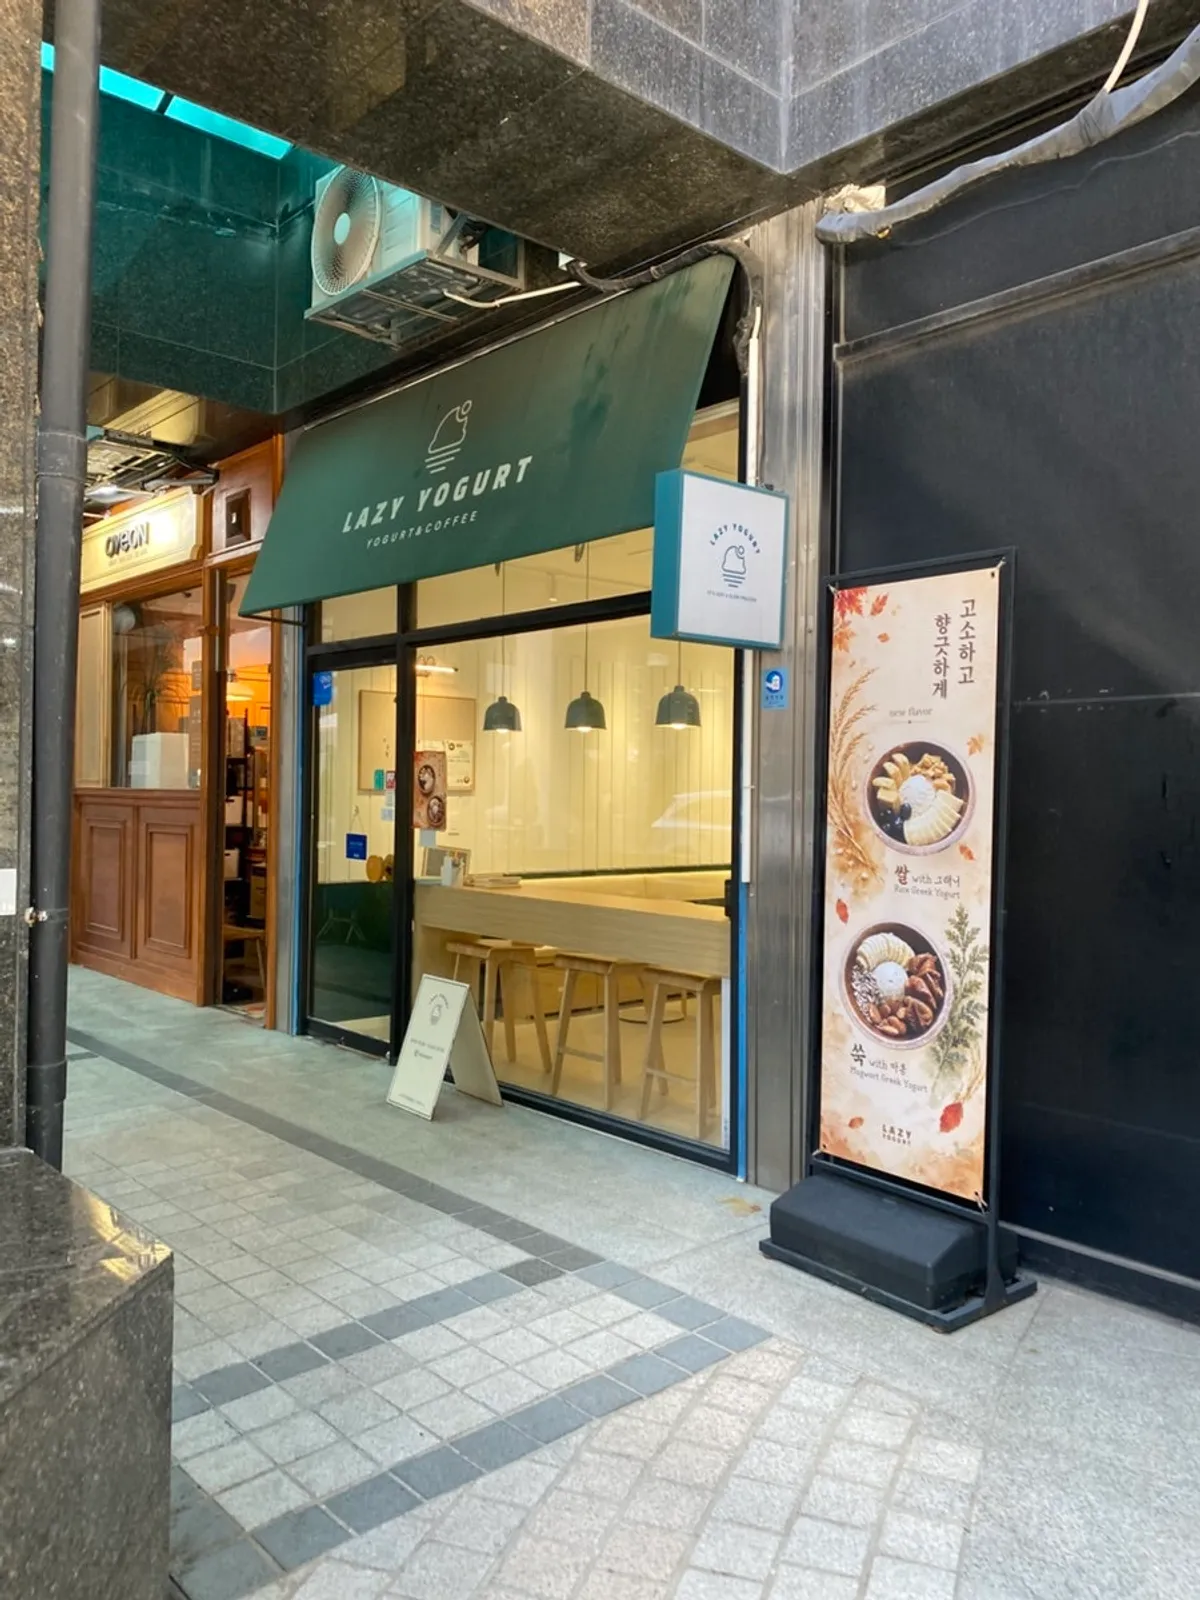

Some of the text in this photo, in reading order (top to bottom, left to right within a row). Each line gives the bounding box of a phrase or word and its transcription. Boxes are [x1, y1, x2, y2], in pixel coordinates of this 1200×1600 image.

[342, 455, 533, 533] LAZY YOGURT
[366, 511, 478, 549] YOGURT&COFFEE
[710, 522, 761, 554] LAZY YOGURT
[958, 599, 977, 685] 고소하고
[932, 613, 951, 699] 향긋하게
[908, 706, 933, 717] flavor
[894, 864, 910, 886] 쌀
[912, 874, 932, 884] with
[935, 887, 960, 900] Yogurt
[850, 1043, 866, 1066] 쑥
[869, 1059, 888, 1070] with
[903, 1080, 928, 1093] Yogurt
[882, 1124, 911, 1139] LAZY
